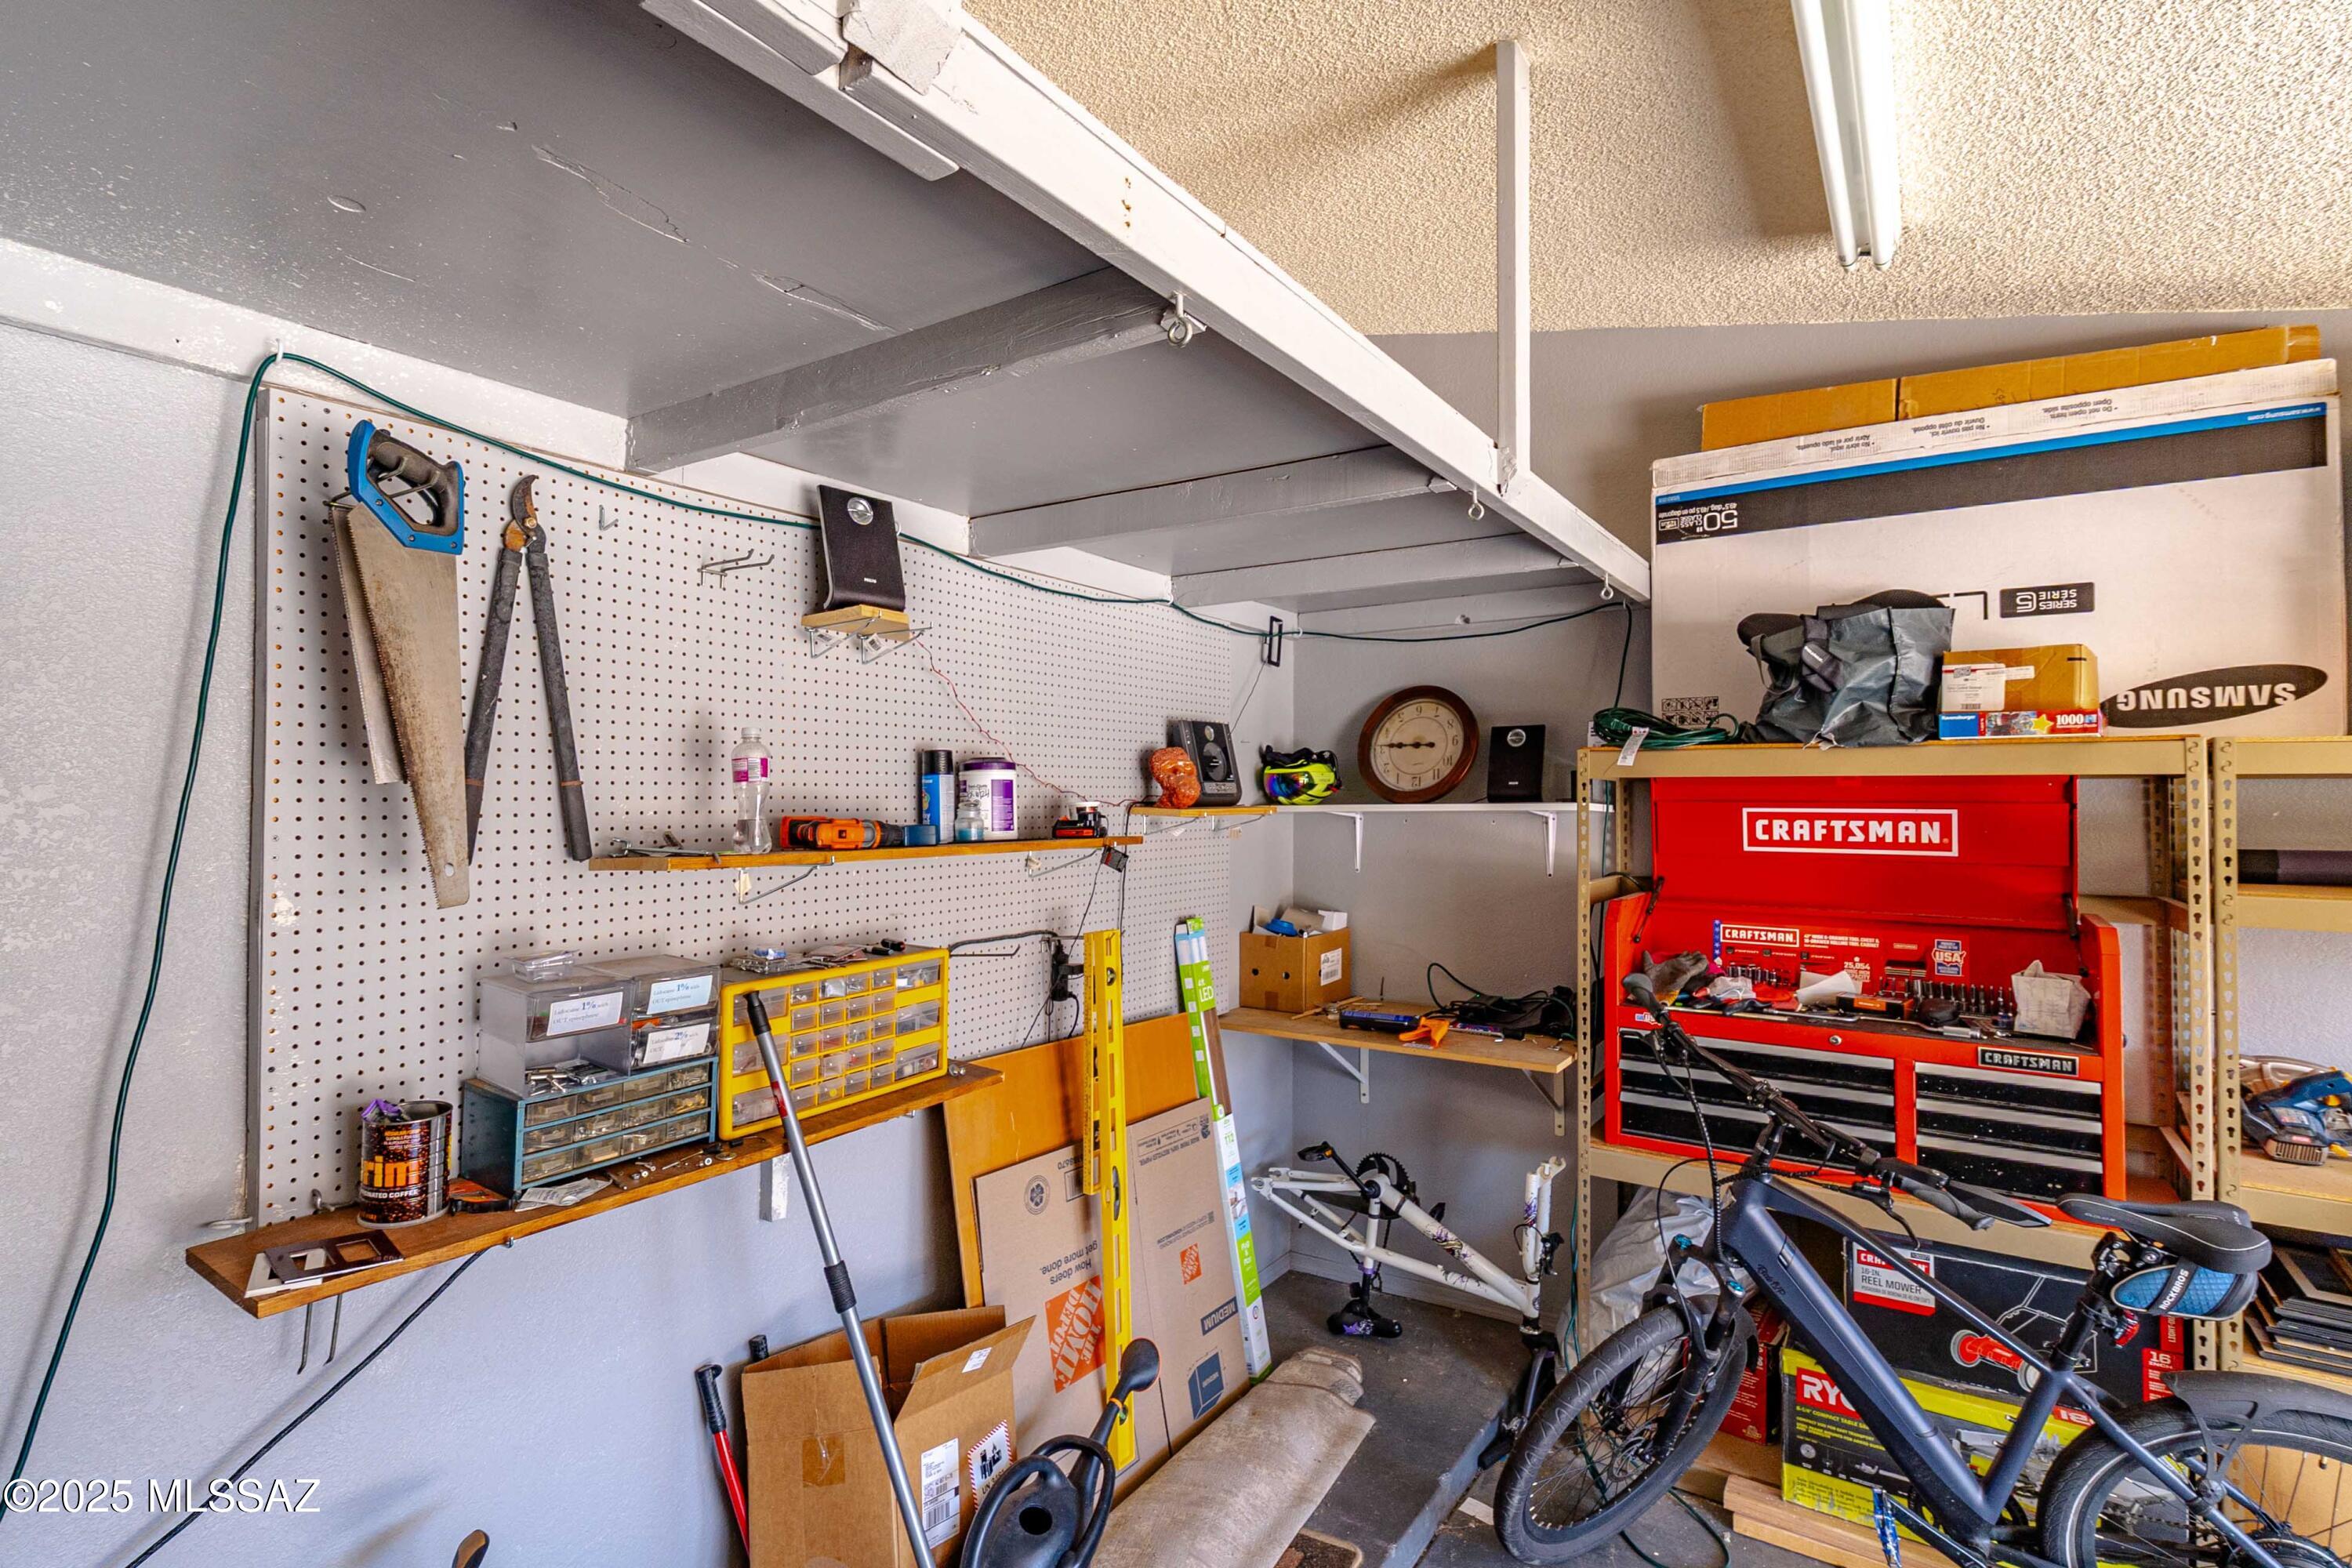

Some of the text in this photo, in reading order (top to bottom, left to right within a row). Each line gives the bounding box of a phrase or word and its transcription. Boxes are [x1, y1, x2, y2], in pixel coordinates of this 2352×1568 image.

[2039, 589, 2077, 601] SÉRIE
[2039, 600, 2077, 610] SERIES
[2117, 683, 2296, 711] SAMSUNG
[2056, 714, 2084, 724] 1000
[1755, 819, 1941, 844] CRAFTSMAN
[1725, 929, 1794, 942] CRAFTSMAN
[1935, 951, 1961, 963] USA
[1200, 985, 1214, 1003] LED
[583, 1001, 596, 1011] 1%
[674, 1032, 688, 1040] 2%
[1984, 1052, 2073, 1072] CRAFTSMAN
[389, 1189, 419, 1199] COFFEE
[1040, 1240, 1098, 1276] get more done.
[1050, 1258, 1092, 1285] How doers
[1861, 1275, 1922, 1295] REEL MOWER
[2158, 1269, 2190, 1310] ROCKBROS
[1050, 1288, 1080, 1357] DEPOT
[1203, 1301, 1236, 1330] MEDIUM
[1054, 1280, 1102, 1388] HOME
[1081, 1323, 1102, 1365] THE
[2150, 1351, 2172, 1365] 16
